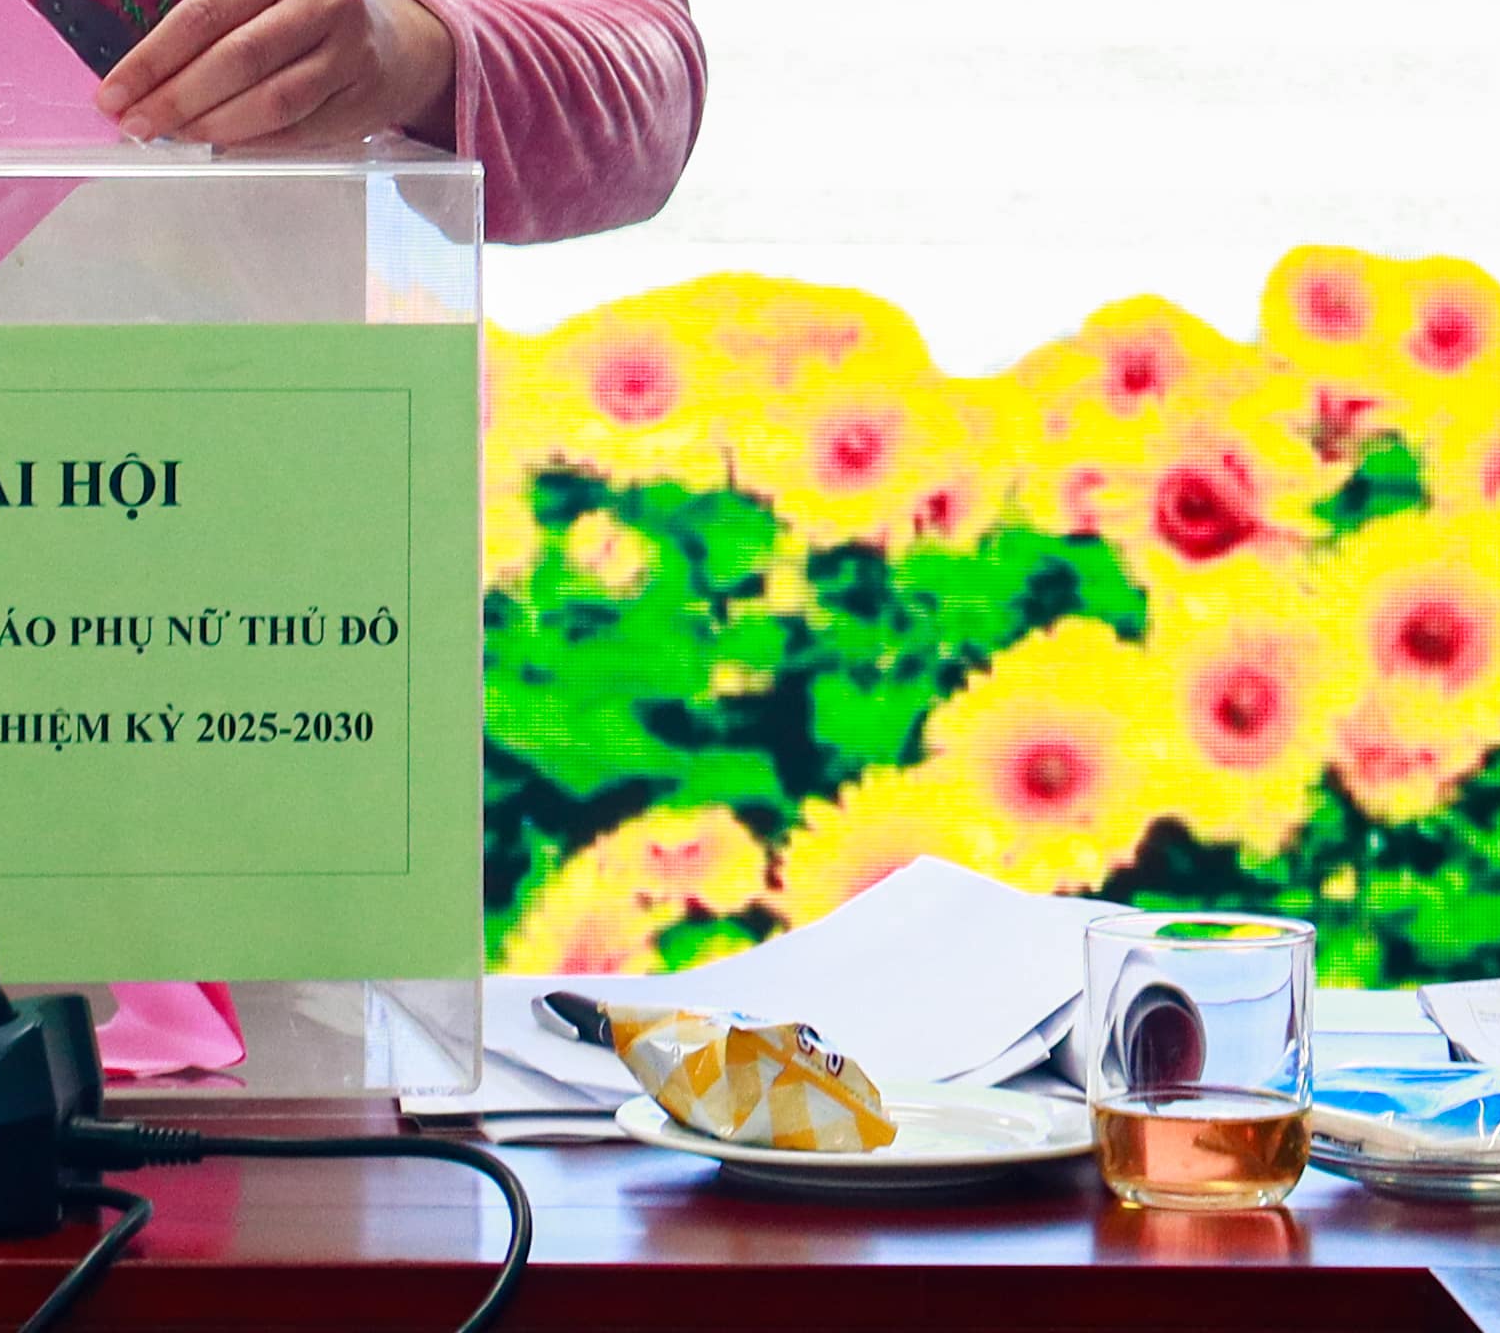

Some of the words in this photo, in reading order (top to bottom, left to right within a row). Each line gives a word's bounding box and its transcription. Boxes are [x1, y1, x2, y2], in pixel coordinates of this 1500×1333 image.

[58, 452, 182, 521] HỘI
[70, 616, 155, 656] PHỤ
[167, 607, 232, 647] NỮ
[239, 606, 327, 647] THỦ
[339, 606, 400, 647] ĐÔ
[125, 703, 186, 744] KỲ
[196, 711, 374, 745] 2025-2030
